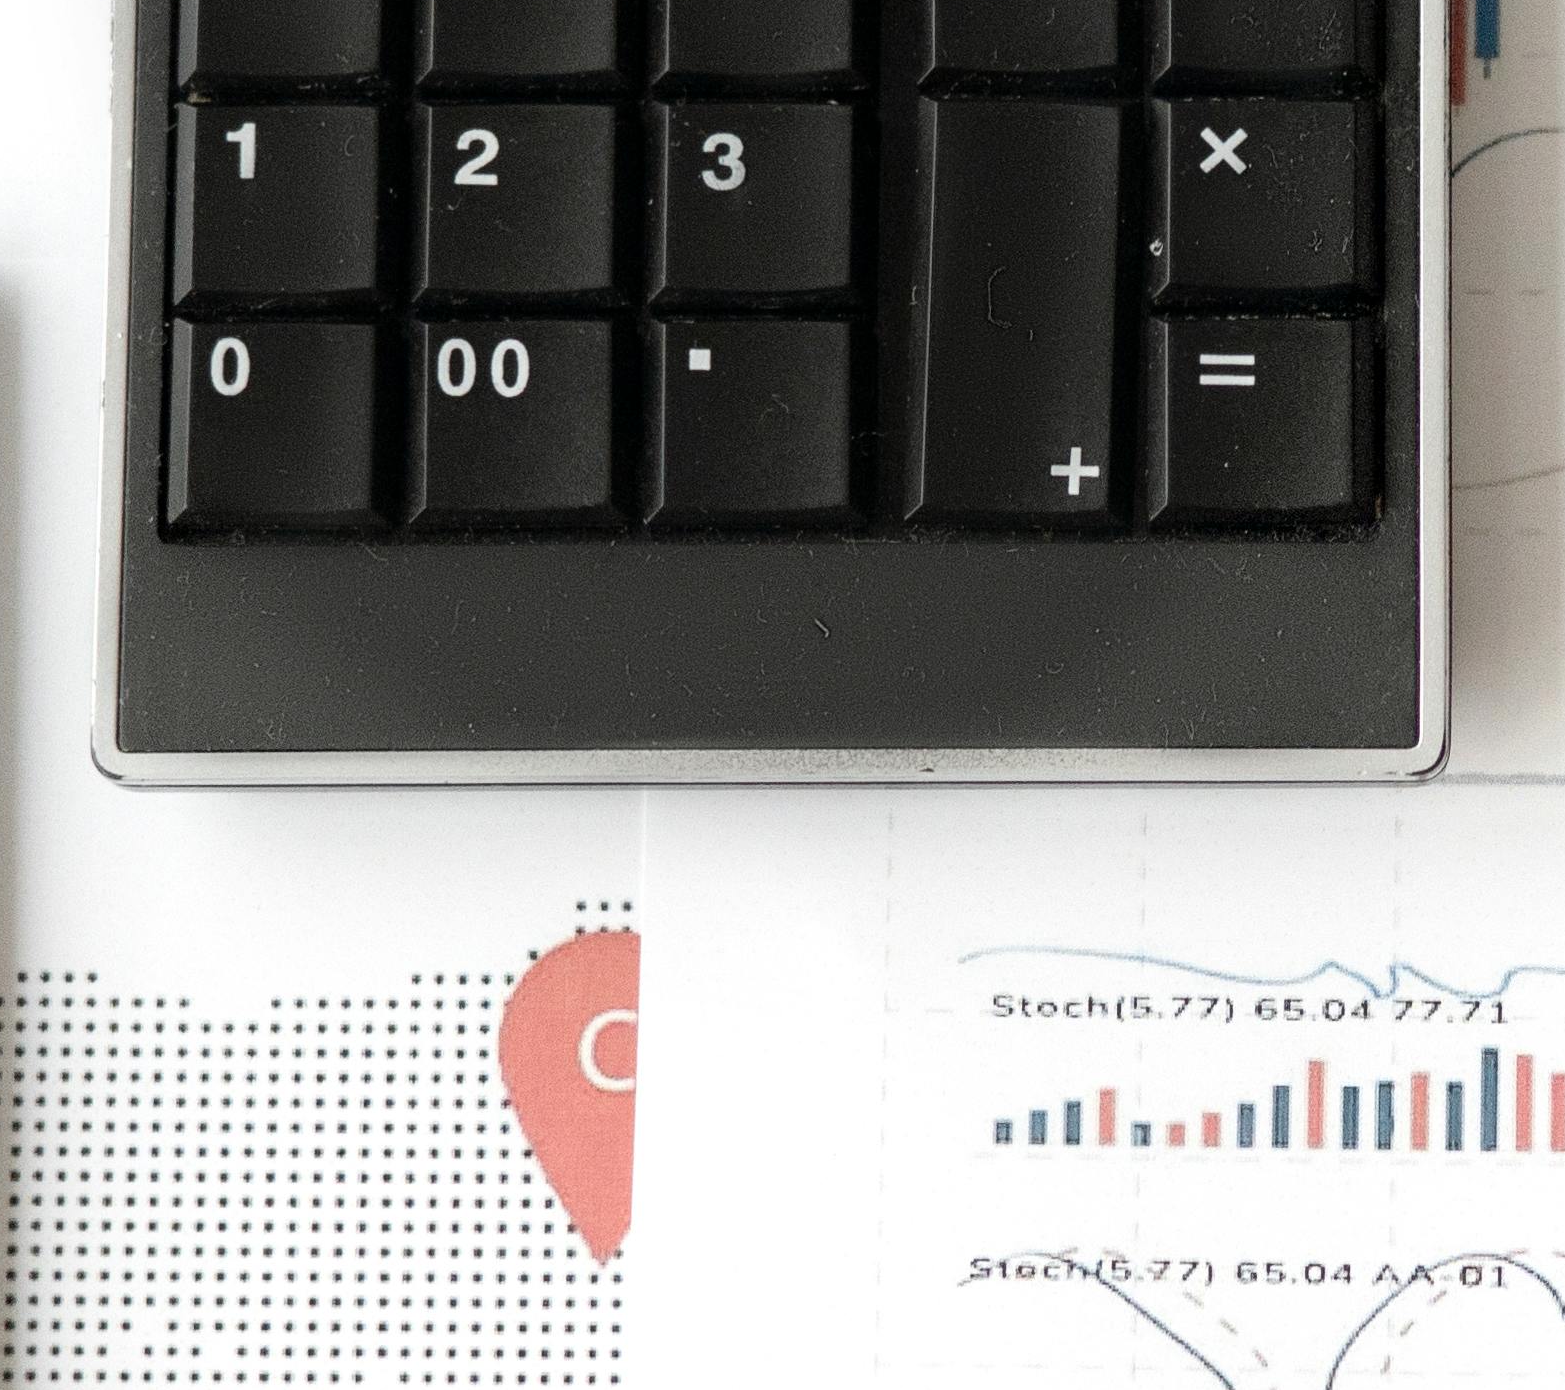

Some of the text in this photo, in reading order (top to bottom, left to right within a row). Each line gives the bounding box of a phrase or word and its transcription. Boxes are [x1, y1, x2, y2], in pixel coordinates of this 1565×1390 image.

[226, 122, 256, 179] 1
[454, 129, 499, 186] 2
[702, 133, 746, 191] 3
[210, 337, 250, 396] 0
[437, 338, 530, 398] 00
[991, 994, 1510, 1025] Stoch(5.77) 65.04 77.71
[1236, 1261, 1354, 1287] 65.04
